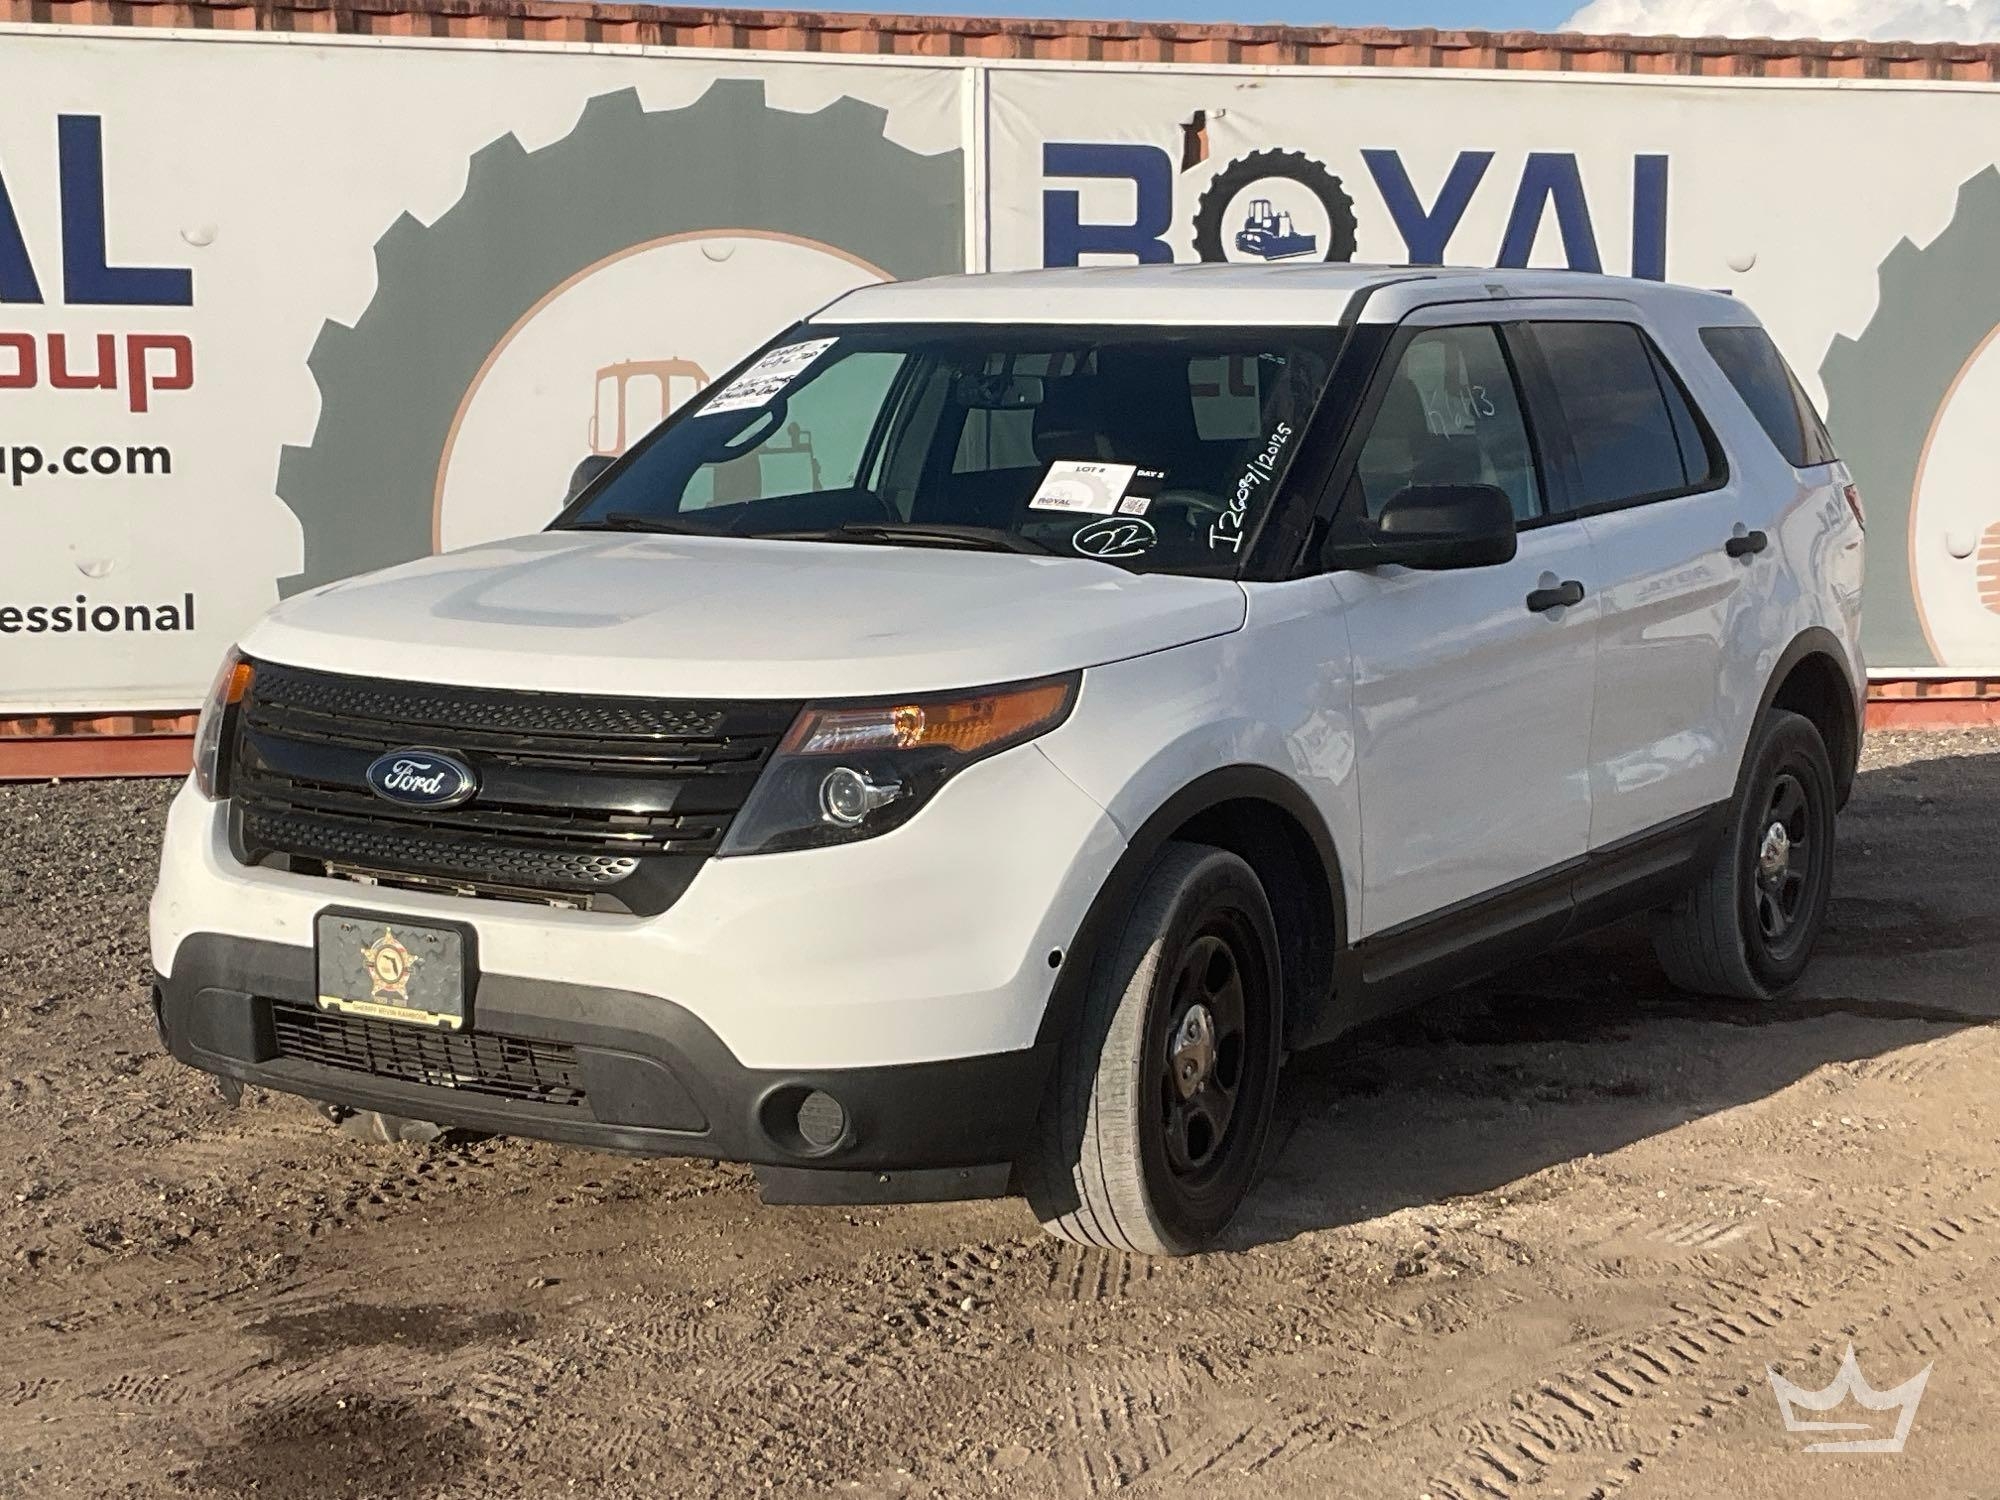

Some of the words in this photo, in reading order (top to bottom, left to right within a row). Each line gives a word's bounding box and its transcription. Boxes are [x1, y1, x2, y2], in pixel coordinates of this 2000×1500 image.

[0, 445, 172, 486] p.com
[1137, 469, 1157, 477] DAY
[1038, 497, 1071, 505] ROYAL
[0, 593, 195, 633] essional
[384, 759, 445, 794] Ford
